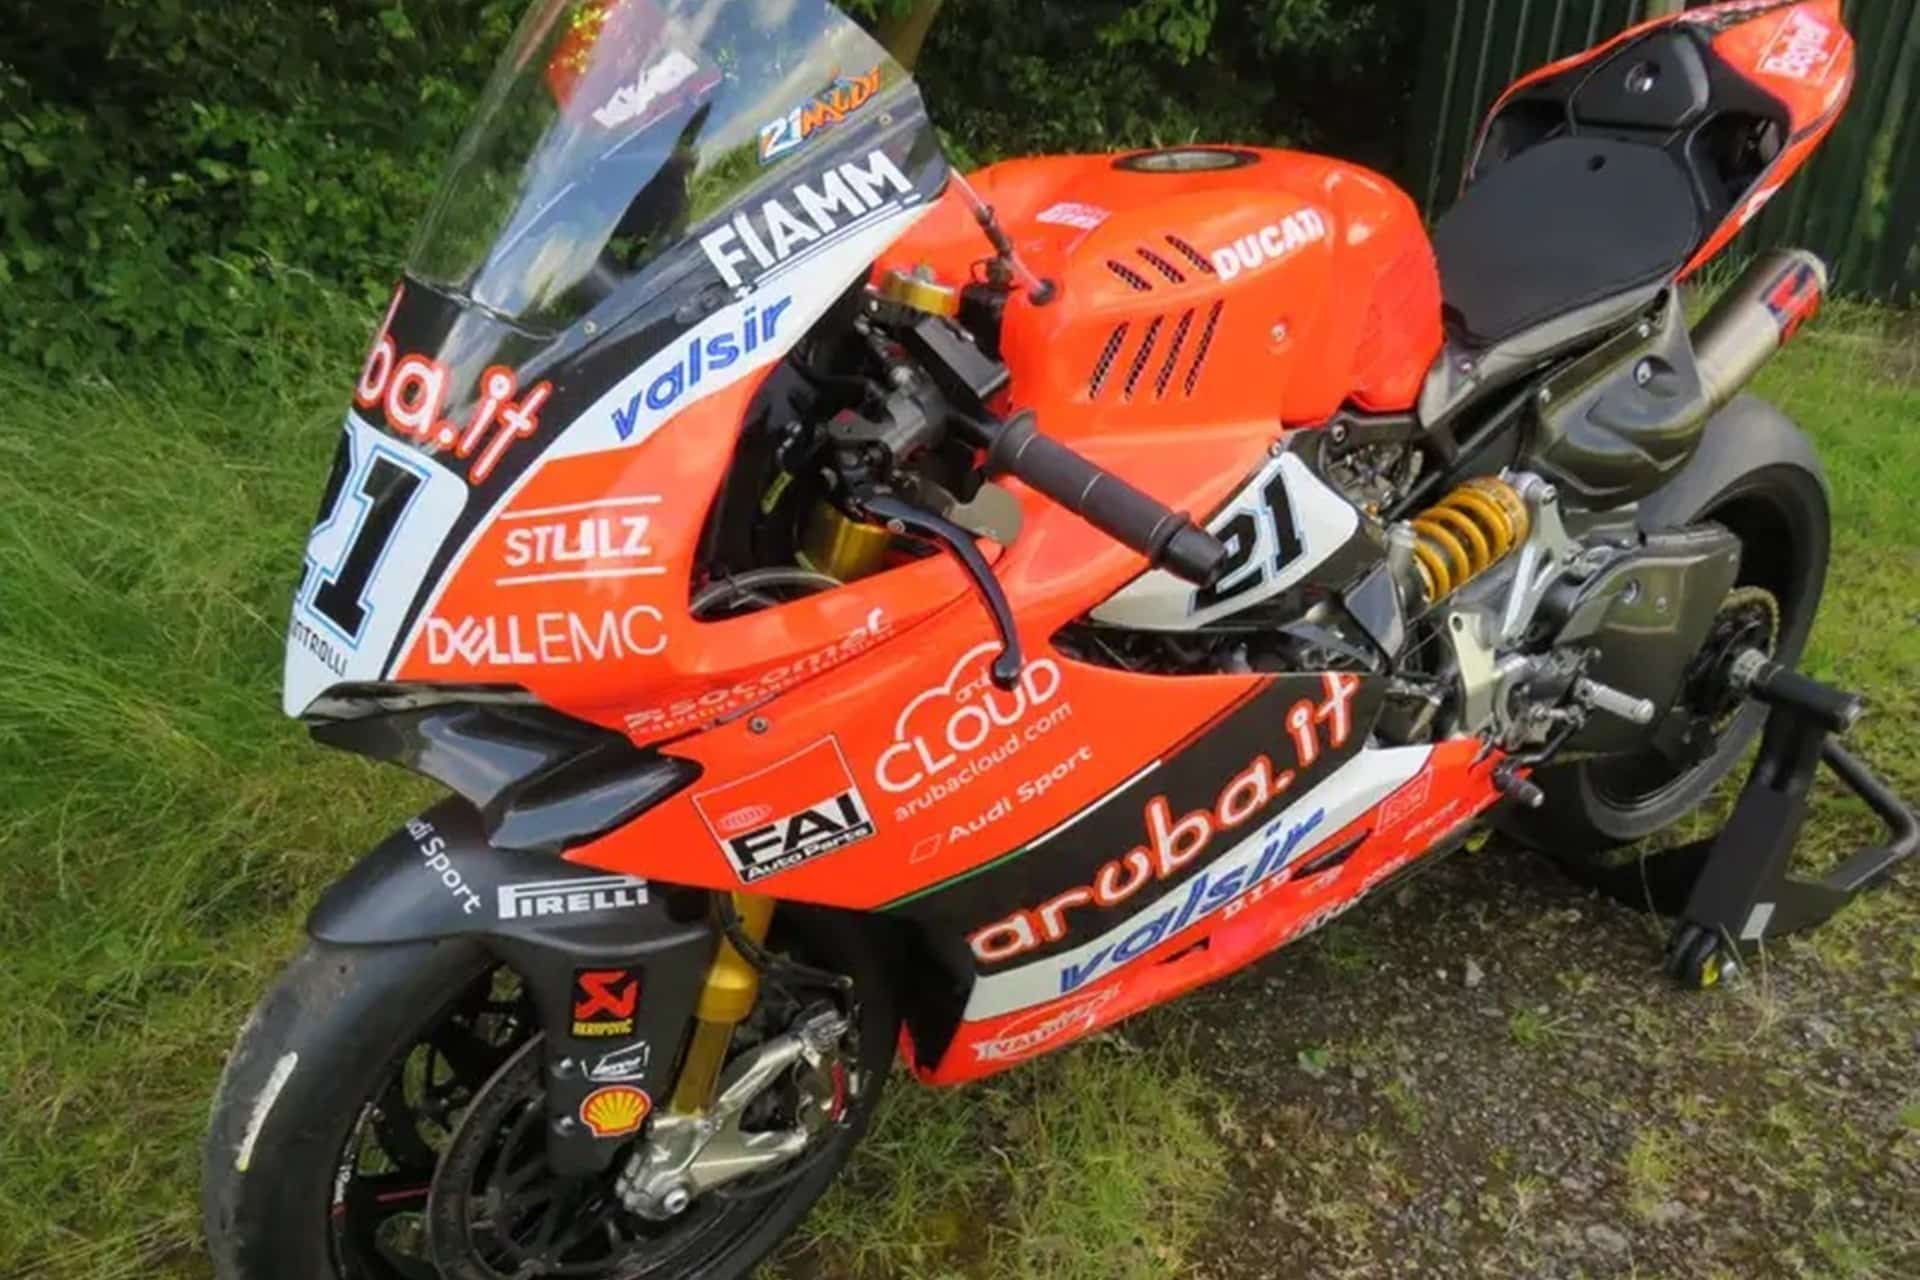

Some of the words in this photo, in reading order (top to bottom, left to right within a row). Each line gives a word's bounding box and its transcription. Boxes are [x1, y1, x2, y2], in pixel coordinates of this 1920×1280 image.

[699, 149, 913, 289] FIAMM
[610, 295, 793, 441] valsir
[503, 514, 652, 568] STULZ
[875, 657, 1061, 793] CLOUD
[893, 701, 1073, 822] arubacloud.com
[728, 792, 862, 868] FAI
[948, 796, 1014, 844] Audi
[1016, 745, 1094, 803] Sport
[966, 671, 1359, 964] aruba.it
[421, 836, 482, 915] Sport
[497, 874, 649, 920] PIRELLI
[747, 851, 803, 880] Auto
[803, 826, 870, 857] Parts
[1059, 806, 1326, 993] valsir
